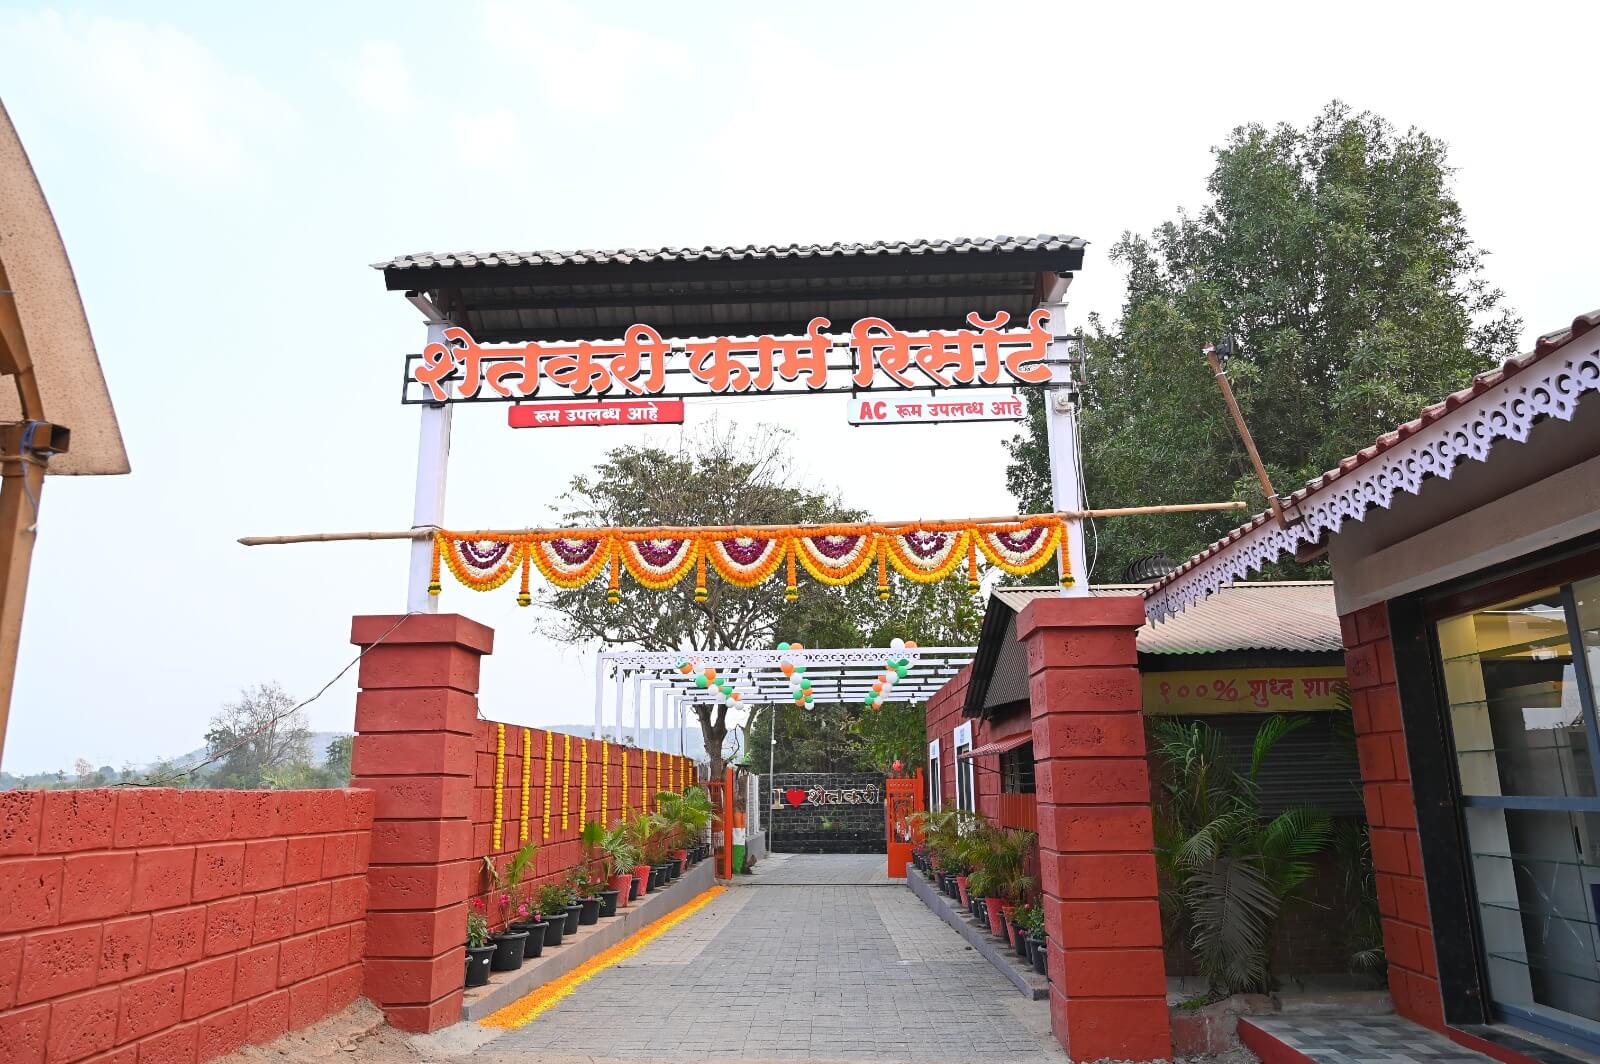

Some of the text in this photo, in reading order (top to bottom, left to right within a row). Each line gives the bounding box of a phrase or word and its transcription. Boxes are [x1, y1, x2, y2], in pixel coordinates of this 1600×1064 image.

[415, 308, 1054, 401] शेतकरी फार्म रिसॉर्ट
[533, 402, 660, 423] रूम उपलब्ध आहे
[859, 396, 1023, 420] AC रूम उपलब्ध आहे
[1159, 678, 1240, 705] १००%
[771, 783, 880, 810] I शेतकरी
